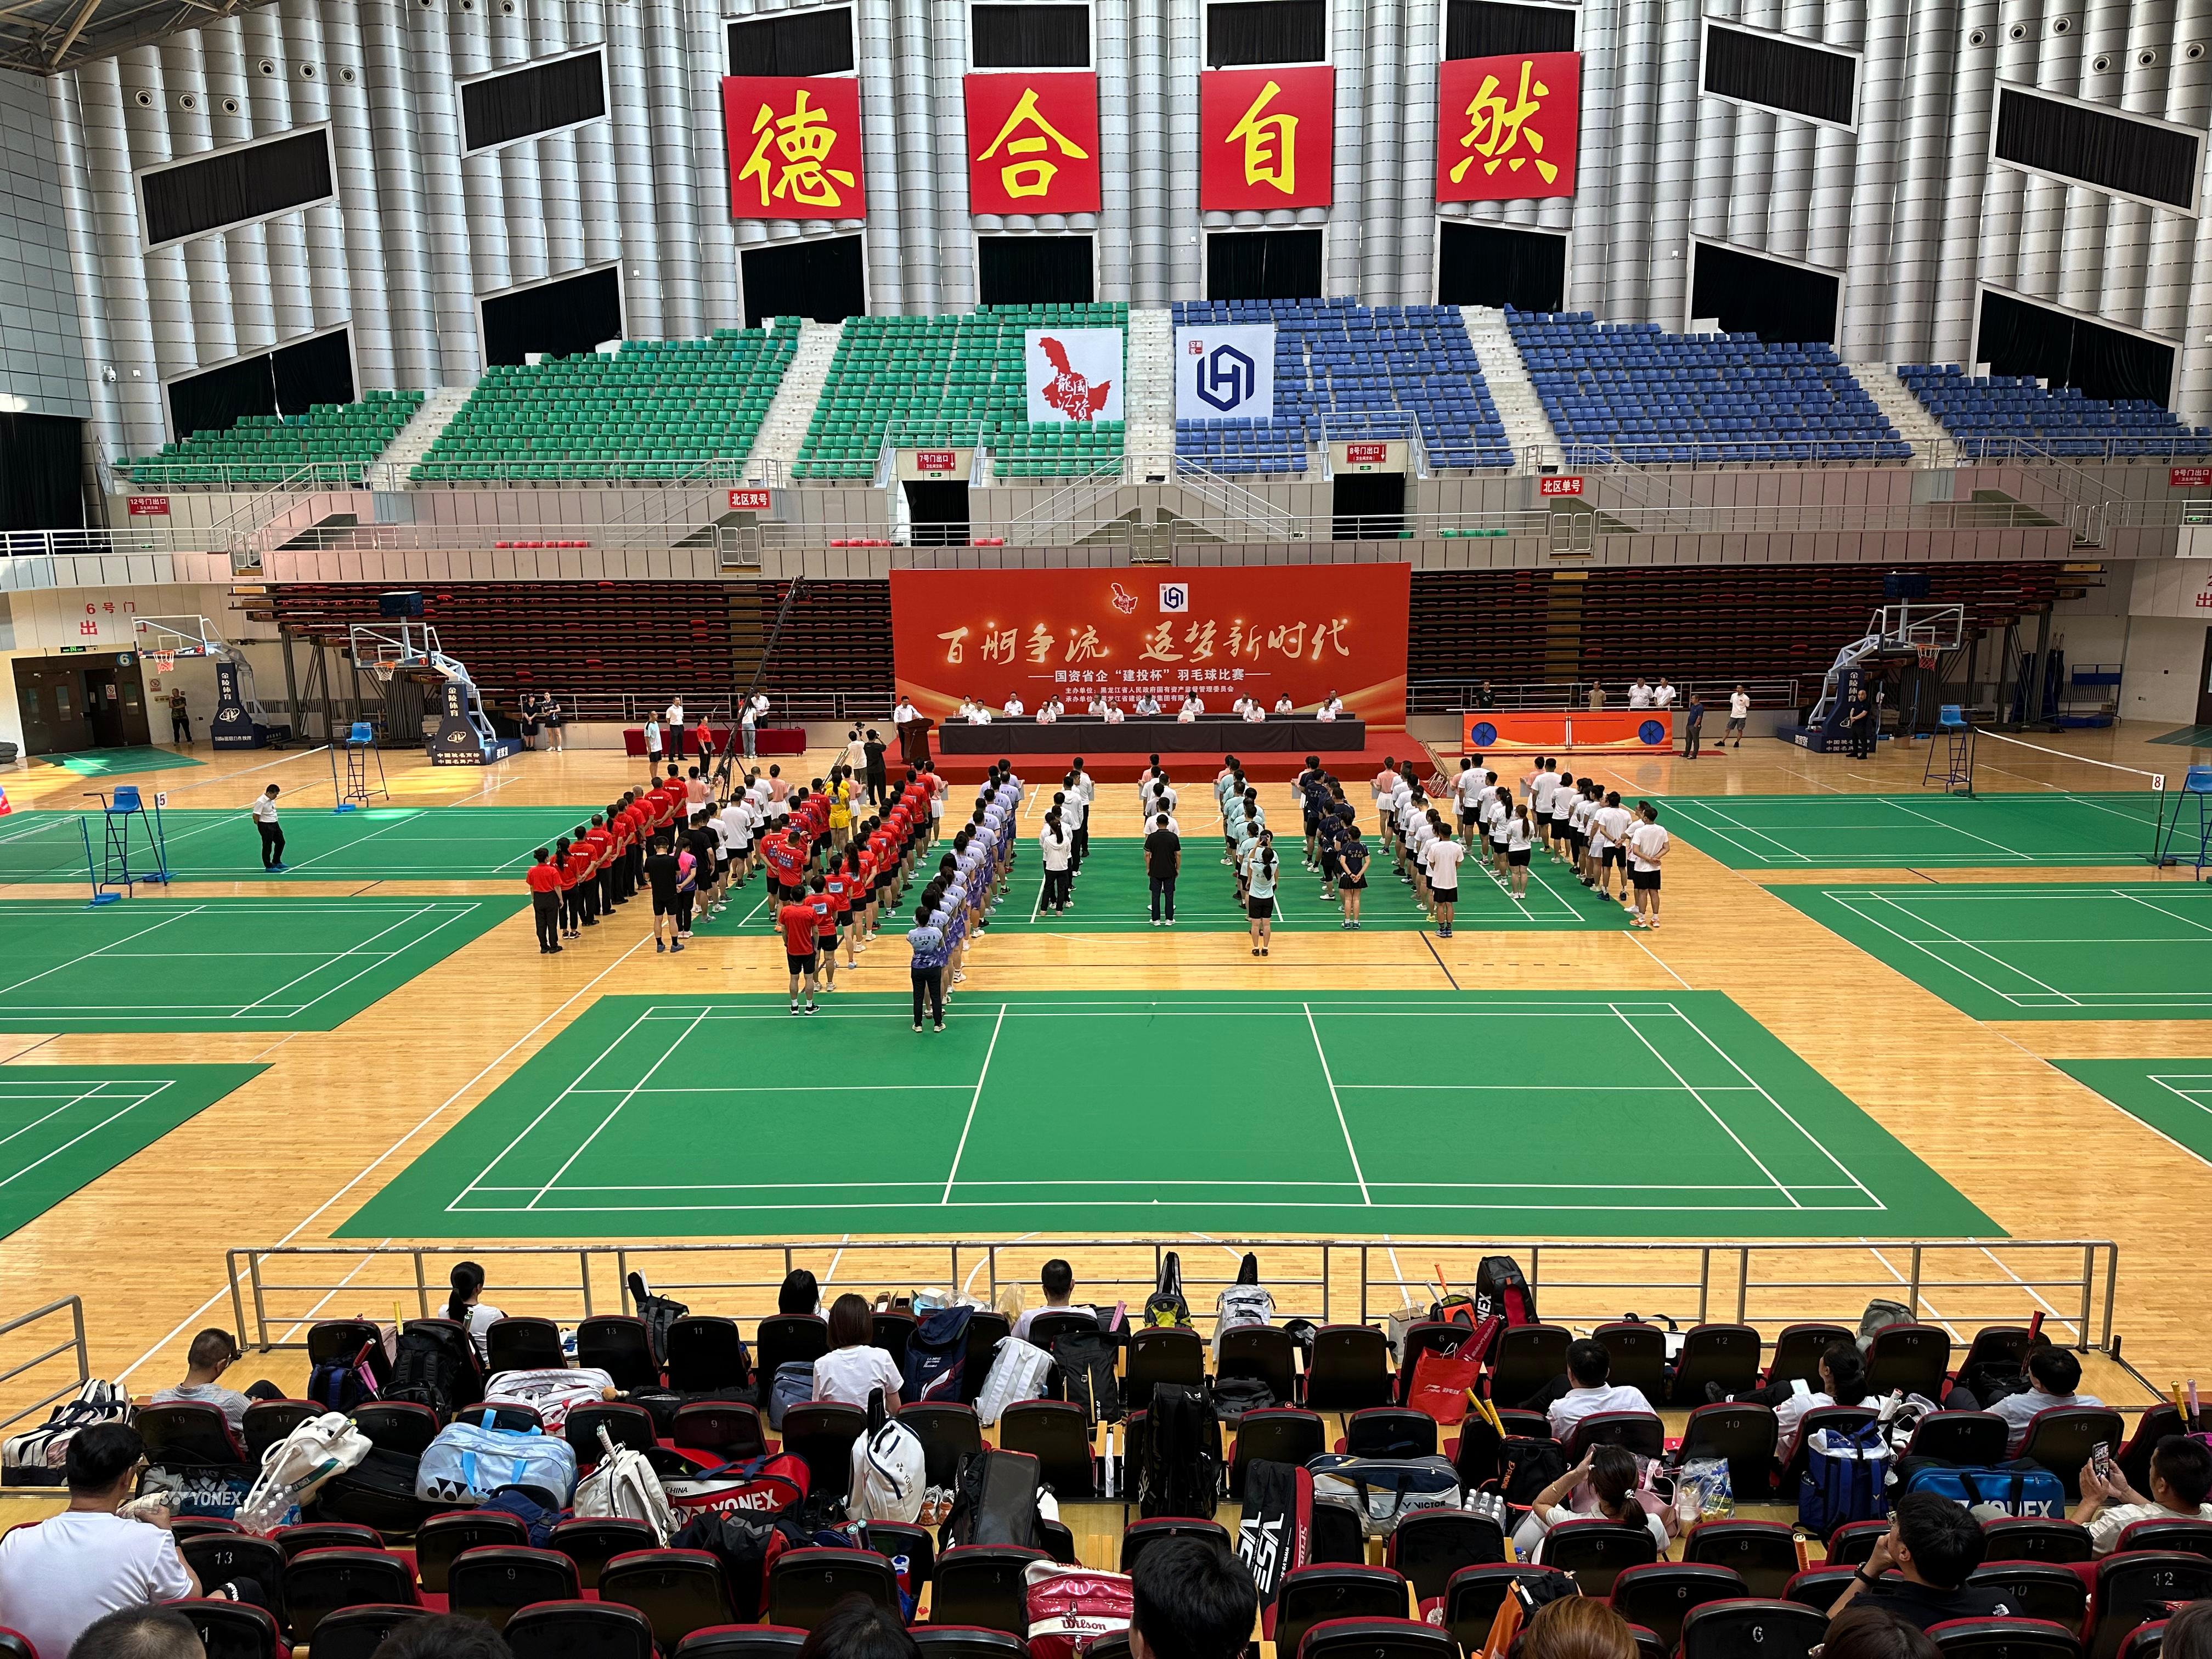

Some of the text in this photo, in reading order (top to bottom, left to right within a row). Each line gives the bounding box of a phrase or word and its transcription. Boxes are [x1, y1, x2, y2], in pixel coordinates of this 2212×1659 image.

[738, 60, 1558, 206] 德 合 自 然
[1350, 447, 1379, 455] 8号门出口
[919, 454, 948, 463] 7号门出口
[1543, 479, 1581, 493] 北区单号
[732, 493, 768, 506] 北区双号
[86, 601, 136, 614] 6号门
[1138, 619, 1350, 663] 逐梦新时代
[119, 654, 129, 665] 6
[2154, 776, 2161, 788] 8
[160, 794, 165, 805] 5
[385, 1418, 397, 1426] 15
[711, 1420, 718, 1428] 9
[822, 1418, 828, 1427] 7
[1042, 1417, 1047, 1425] 3
[1725, 1420, 1739, 1429] 10
[2074, 1422, 2088, 1431] 16
[1274, 1426, 1282, 1435] 2
[1388, 1423, 1394, 1432] 4
[1615, 1426, 1622, 1434] 8
[1957, 1426, 1971, 1435] 14
[193, 1491, 242, 1505] YONEX
[710, 1488, 780, 1511] YONEX
[1414, 1500, 1446, 1509] VICTOR
[464, 1530, 477, 1541] 11
[1596, 1541, 1604, 1551] 6
[1740, 1541, 1748, 1551] 8
[215, 1551, 233, 1565] 13
[507, 1568, 516, 1580] 9
[658, 1572, 666, 1585] 7
[825, 1571, 833, 1583] 5
[2153, 1572, 2174, 1585] 12
[1677, 1587, 1687, 1598] 6
[2008, 1585, 2028, 1596] 10
[1061, 1619, 1107, 1630] Wilson
